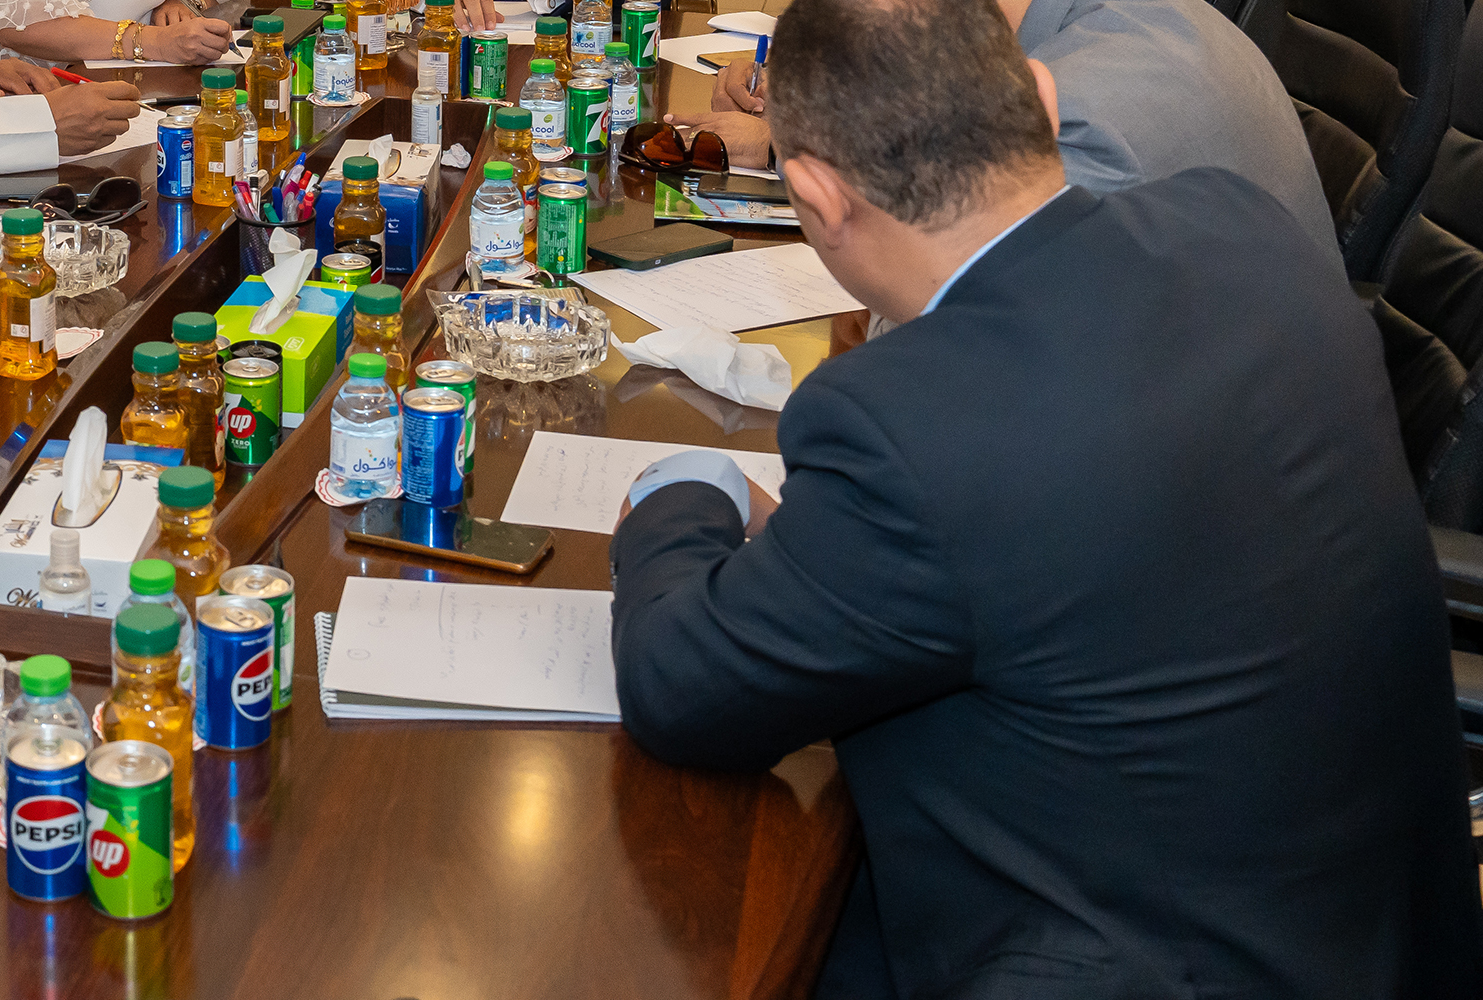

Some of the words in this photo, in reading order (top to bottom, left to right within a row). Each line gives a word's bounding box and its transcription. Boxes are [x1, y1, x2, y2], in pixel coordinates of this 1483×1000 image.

[580, 41, 596, 49] cool
[619, 107, 636, 116] cool
[535, 125, 555, 134] cool
[231, 438, 251, 446] ZERO
[353, 457, 387, 473] كول
[15, 821, 81, 842] PEPSI
